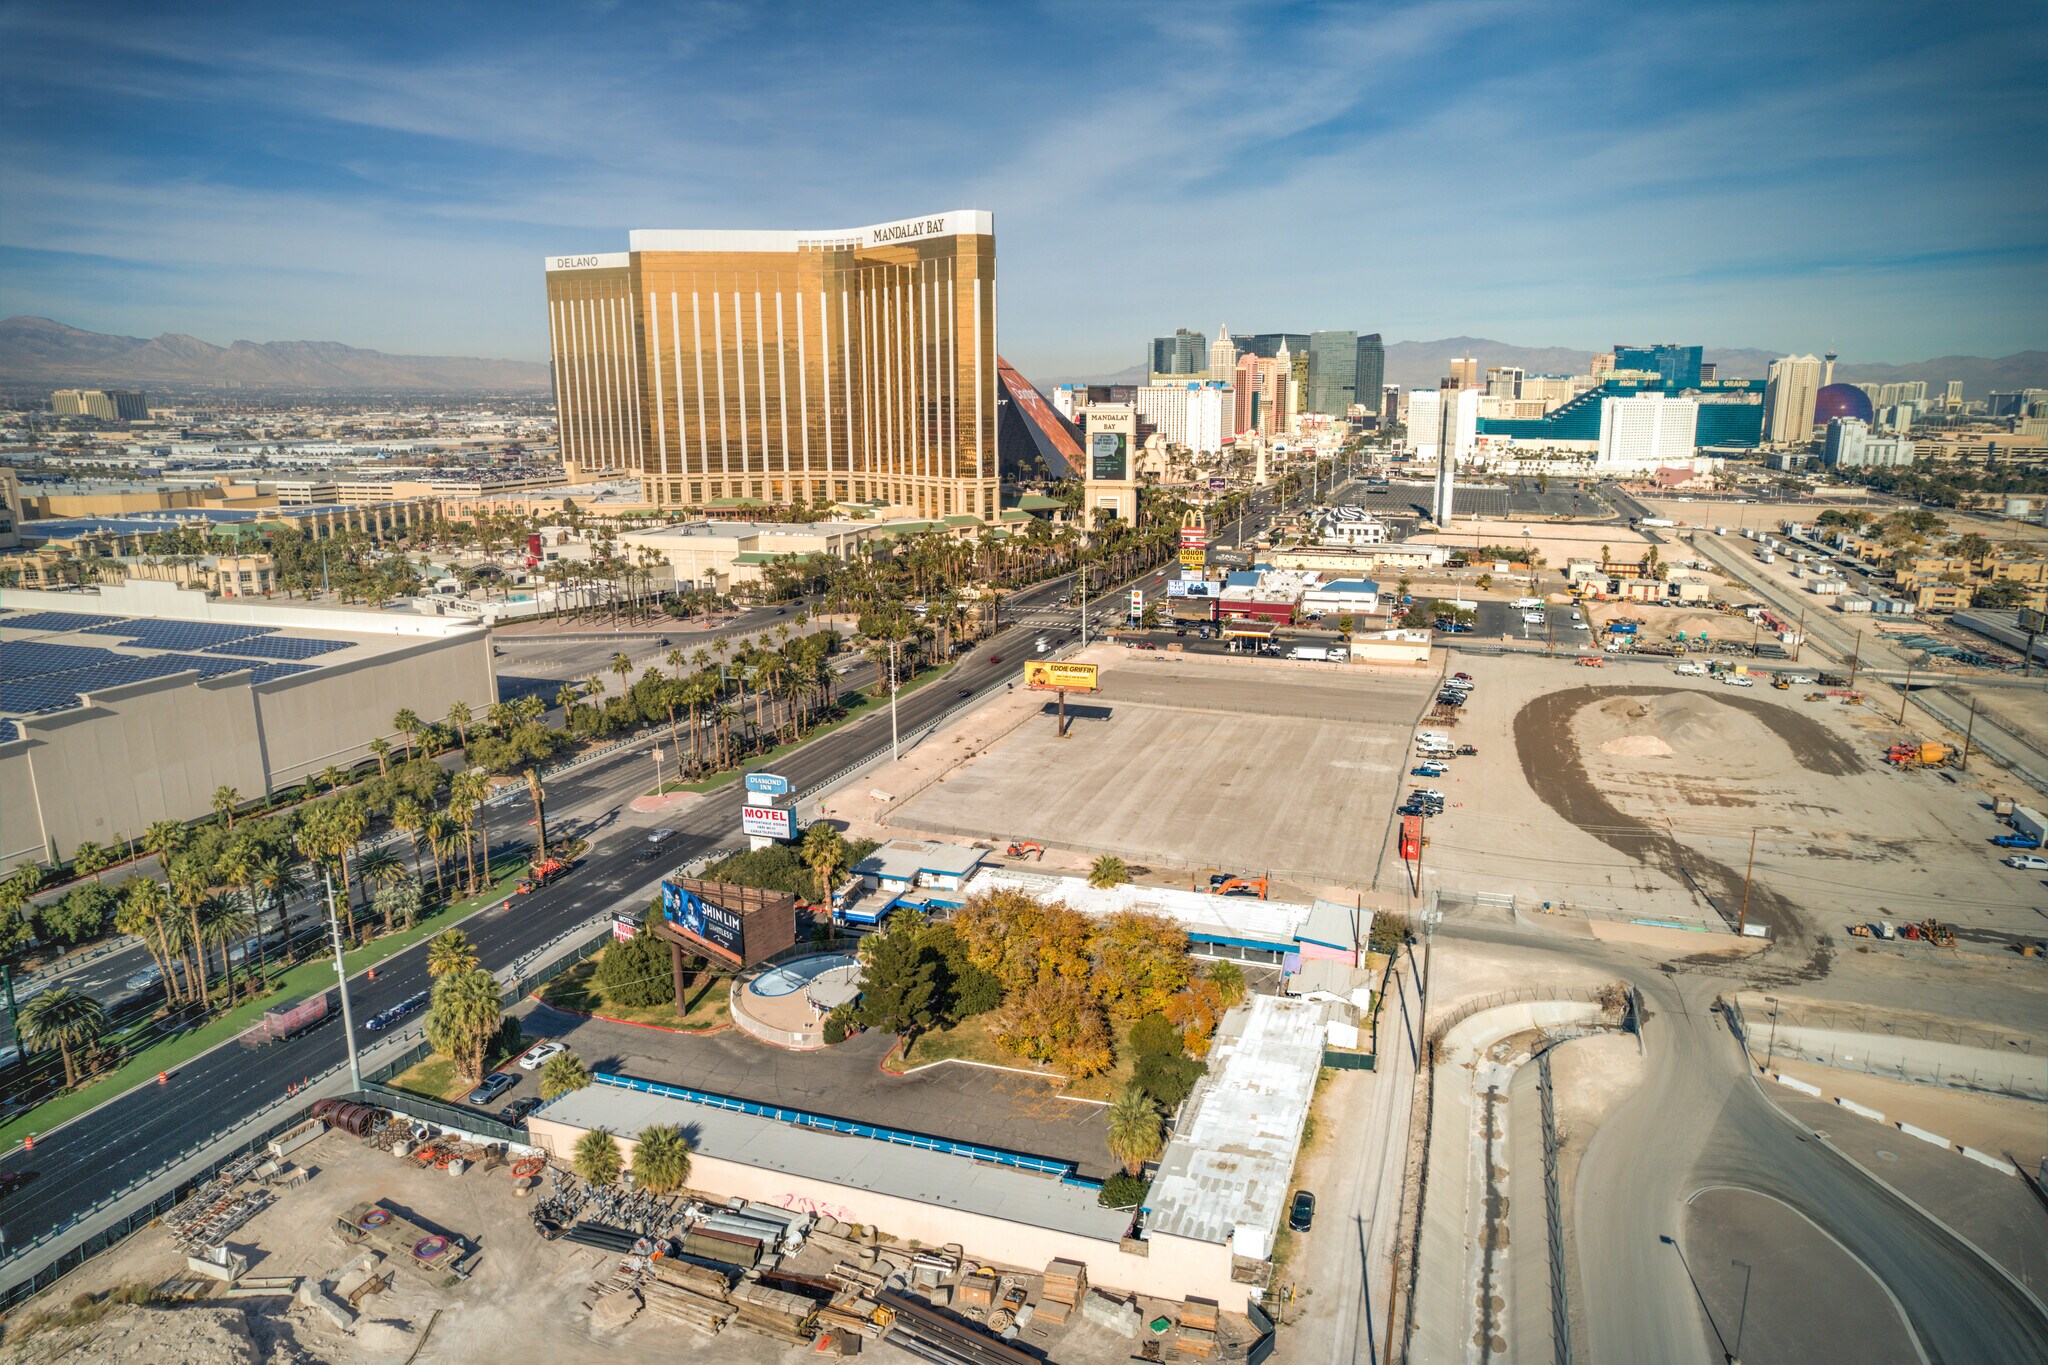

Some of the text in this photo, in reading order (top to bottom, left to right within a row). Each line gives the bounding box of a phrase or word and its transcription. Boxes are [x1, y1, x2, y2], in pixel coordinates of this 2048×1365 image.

[873, 218, 944, 242] MANDALAY BAY
[557, 256, 598, 268] DELANO
[750, 777, 782, 786] DIAMOND
[744, 808, 787, 821] MOTEL
[618, 914, 635, 926] MOTEL
[701, 902, 723, 923] SHIN
[723, 912, 740, 931] LIM
